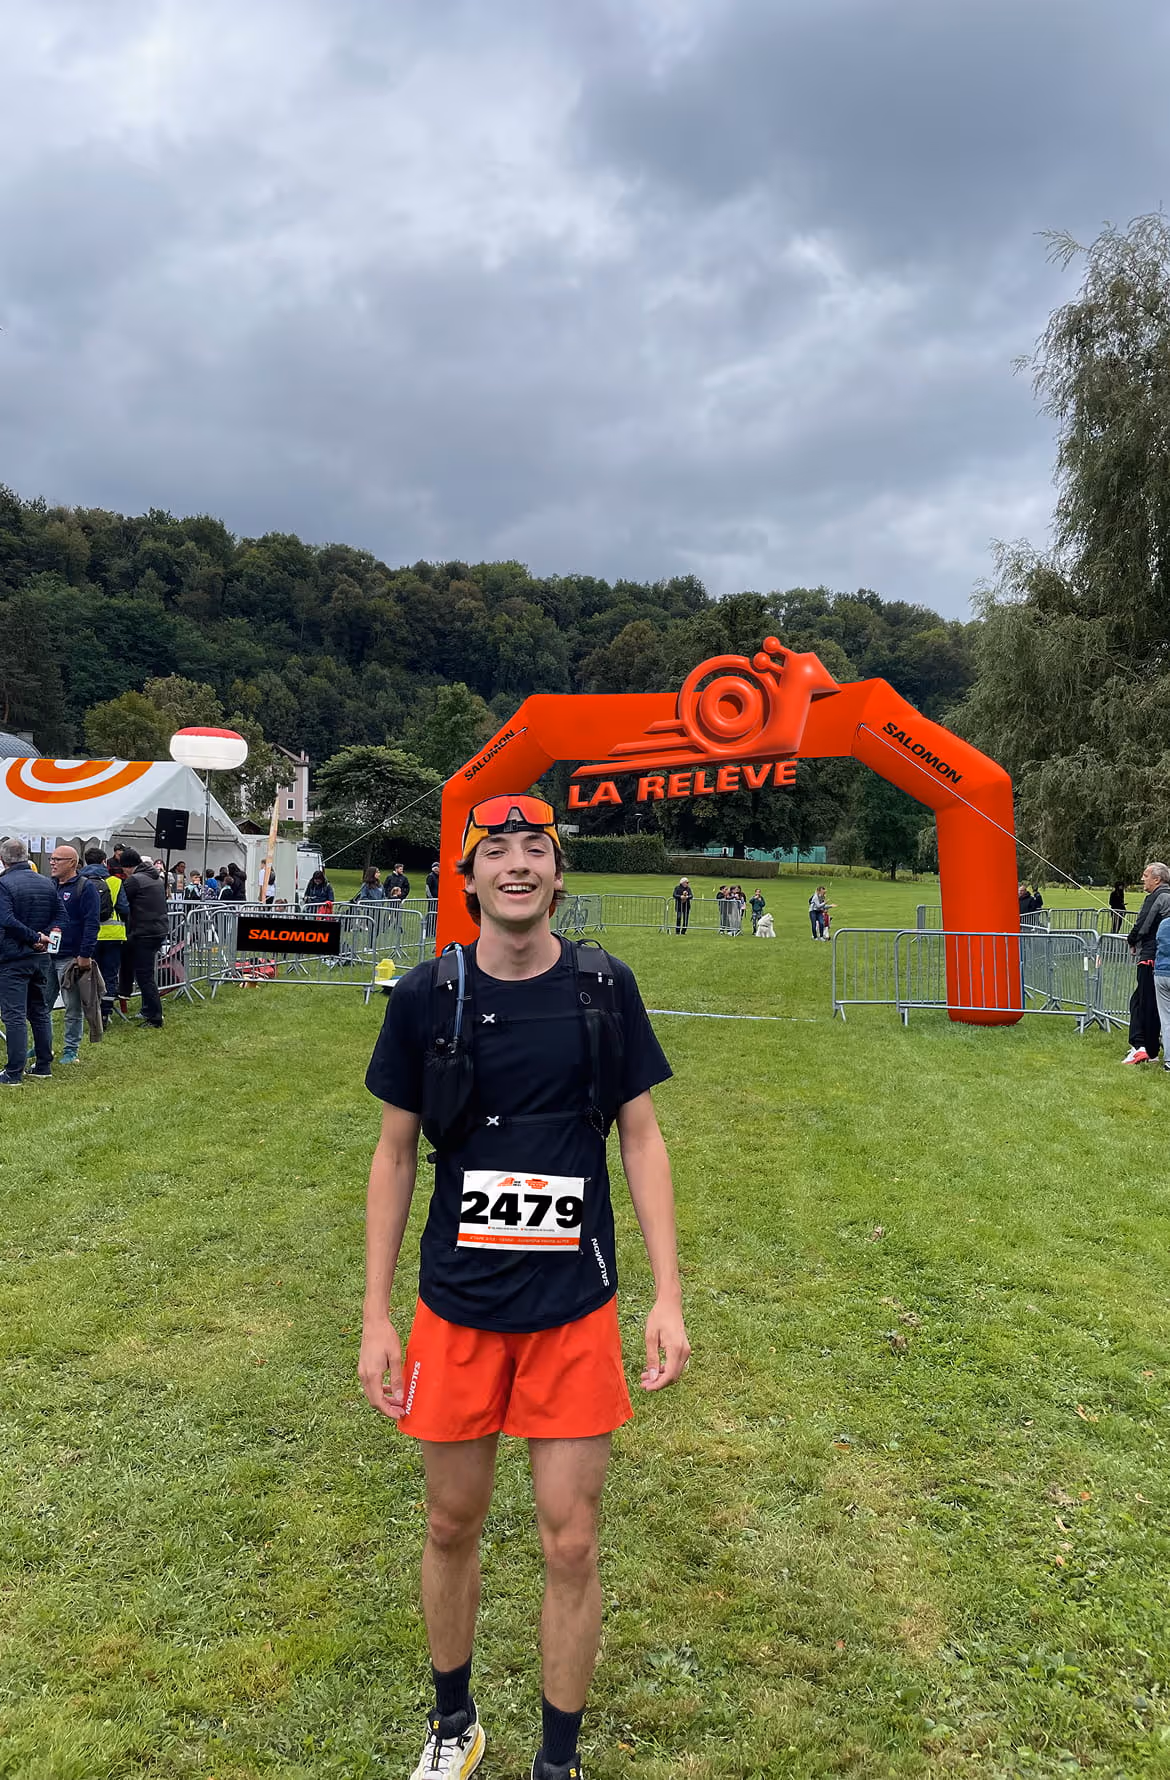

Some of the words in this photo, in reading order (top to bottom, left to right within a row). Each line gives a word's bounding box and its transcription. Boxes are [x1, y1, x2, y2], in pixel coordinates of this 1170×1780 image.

[464, 729, 515, 781] SALOMON
[882, 722, 963, 784] SALOMON
[567, 781, 623, 810] LA
[636, 760, 798, 804] RELÈVE
[248, 929, 330, 943] SALOMON
[460, 1191, 584, 1229] 2479
[591, 1238, 610, 1286] SALOMON
[405, 1361, 421, 1415] SALOMON
